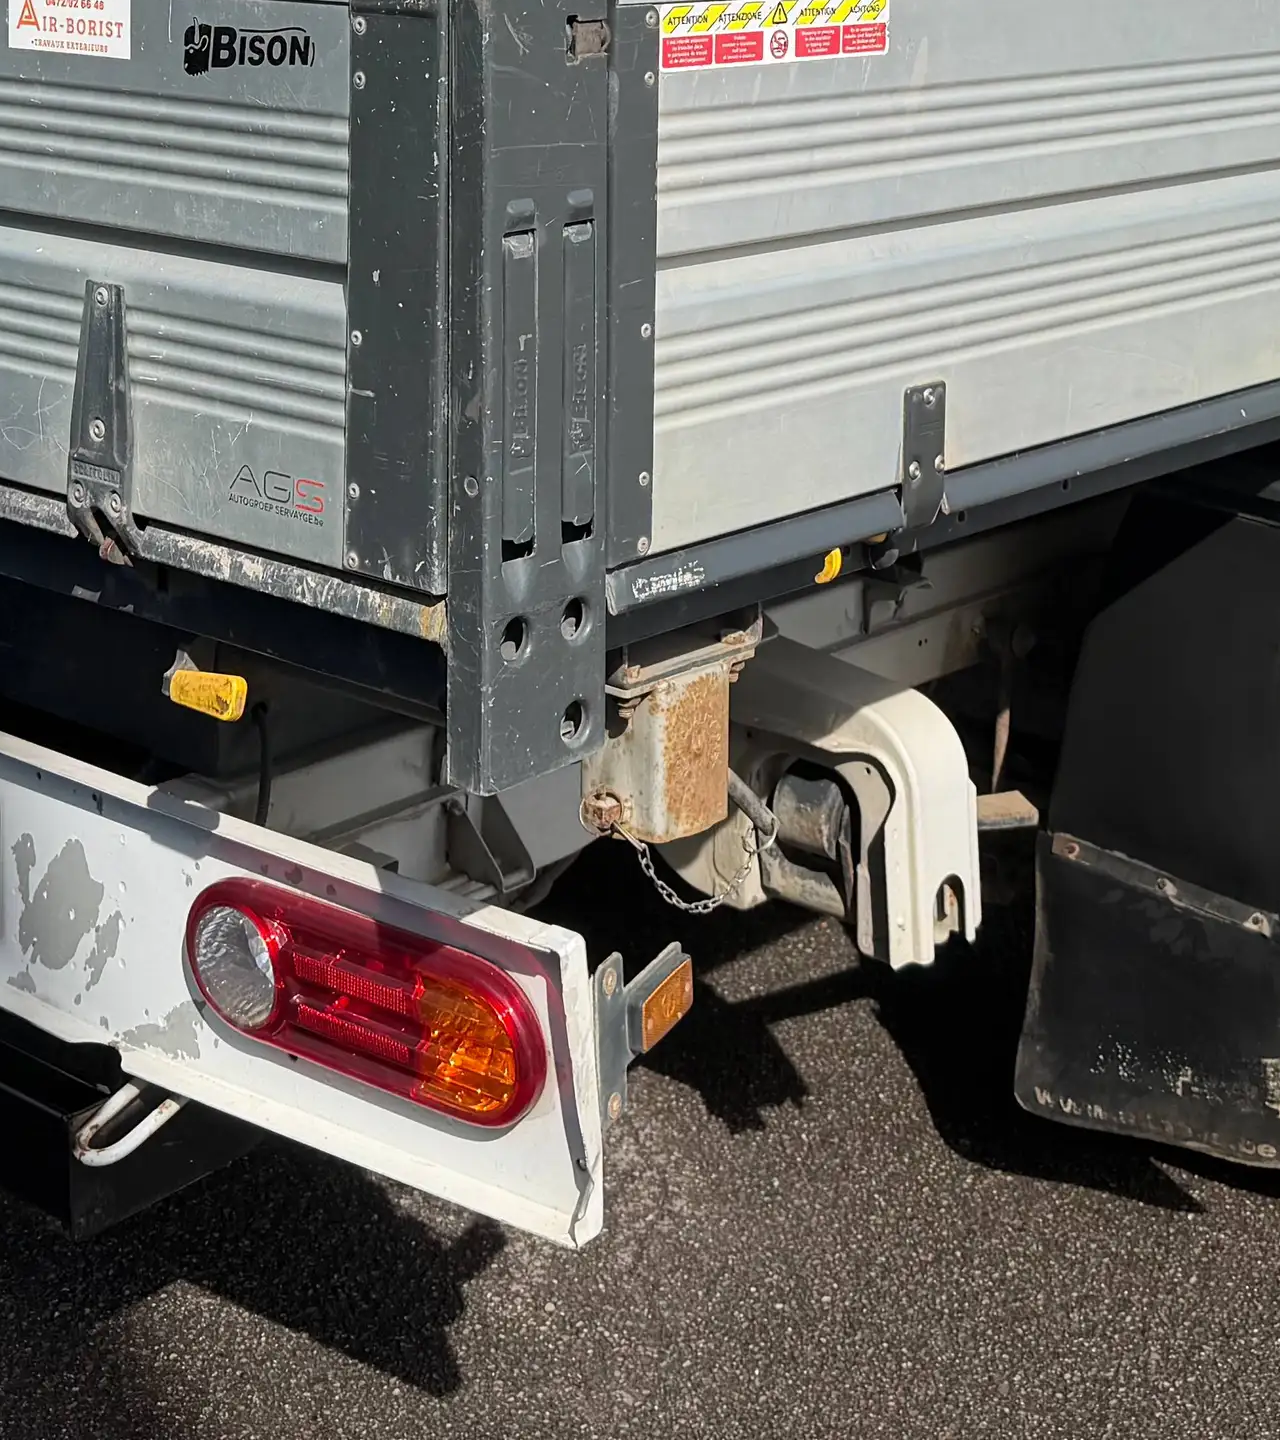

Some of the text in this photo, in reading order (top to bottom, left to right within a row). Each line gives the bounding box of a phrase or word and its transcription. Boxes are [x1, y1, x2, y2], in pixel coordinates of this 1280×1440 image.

[667, 14, 709, 26] ATTENTION
[719, 11, 762, 23] ATTENZIONE
[800, 7, 837, 17] ATTENTION
[228, 493, 274, 513] AUTOGROEP
